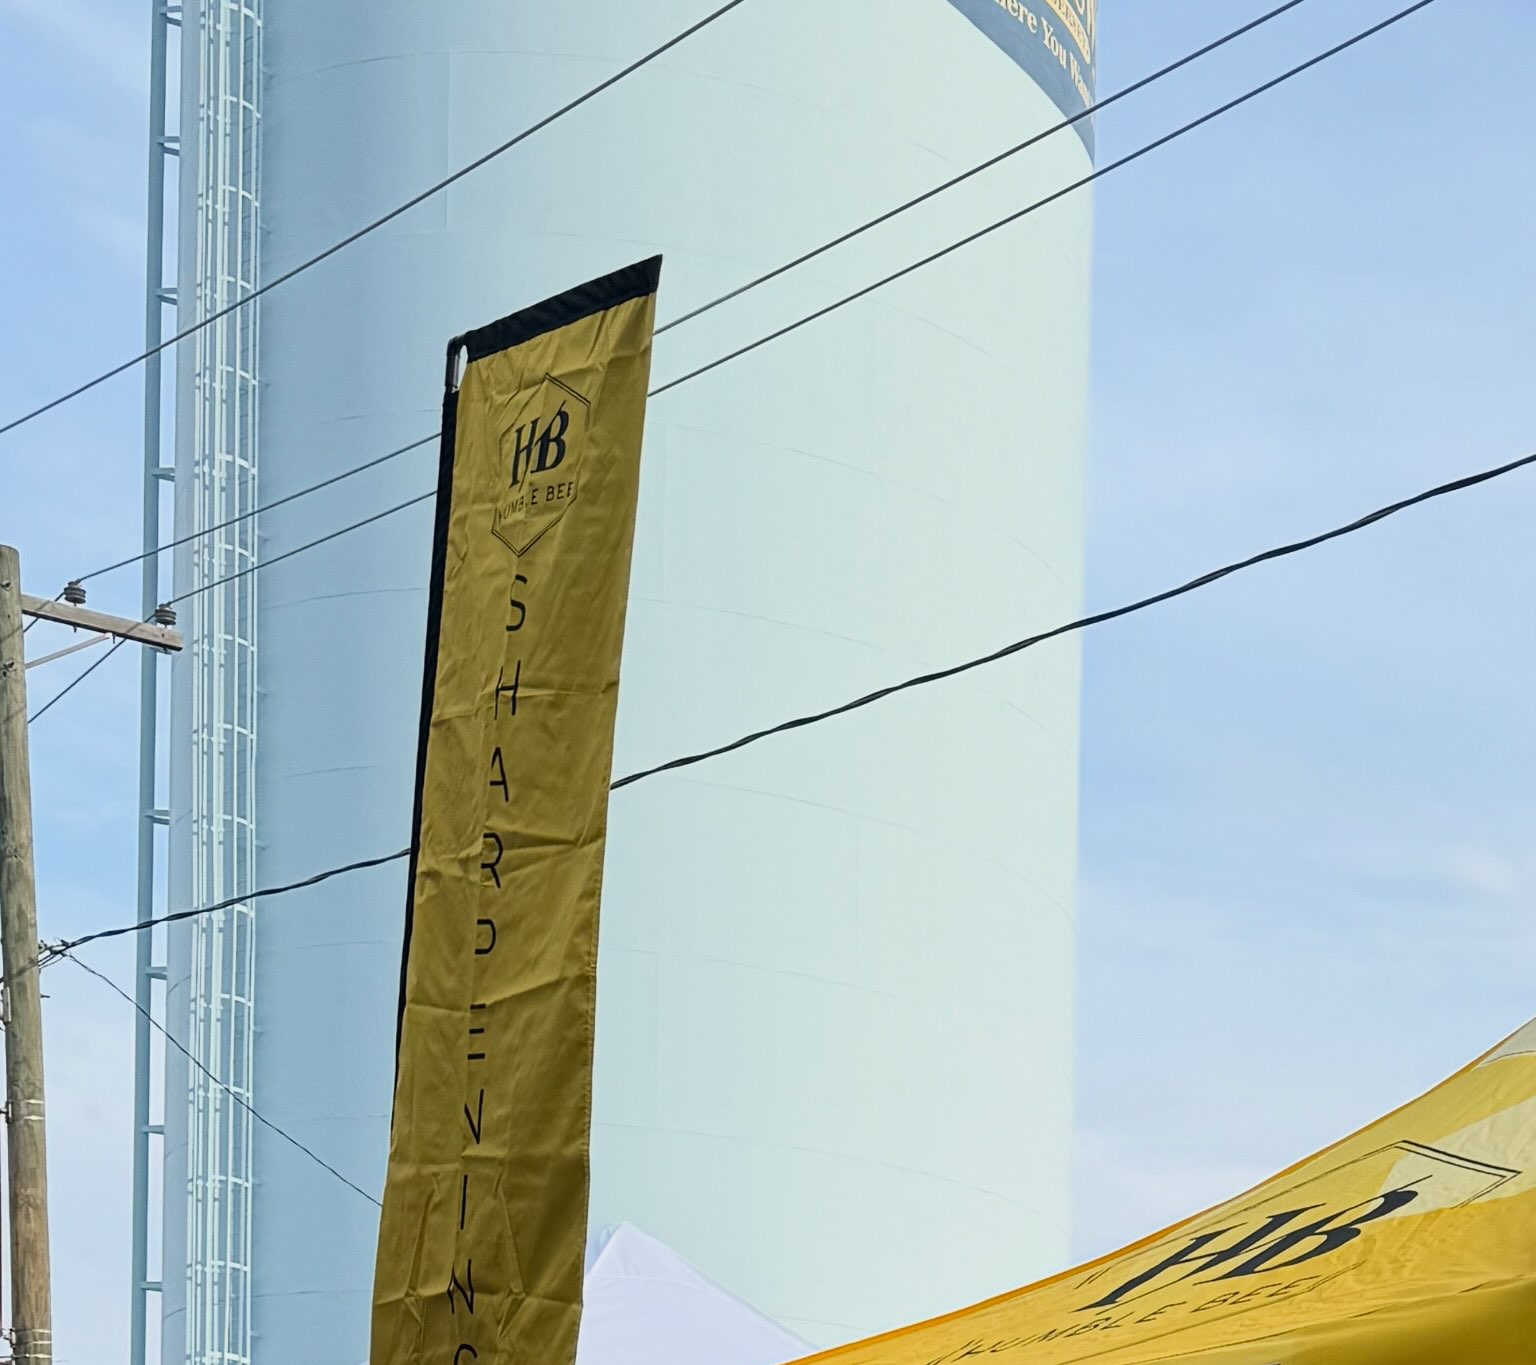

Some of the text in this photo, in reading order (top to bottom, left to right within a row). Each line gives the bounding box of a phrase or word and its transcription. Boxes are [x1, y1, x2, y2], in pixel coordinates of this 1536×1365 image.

[1041, 16, 1067, 70] You
[958, 1274, 1322, 1359] HUMBLE BEE
